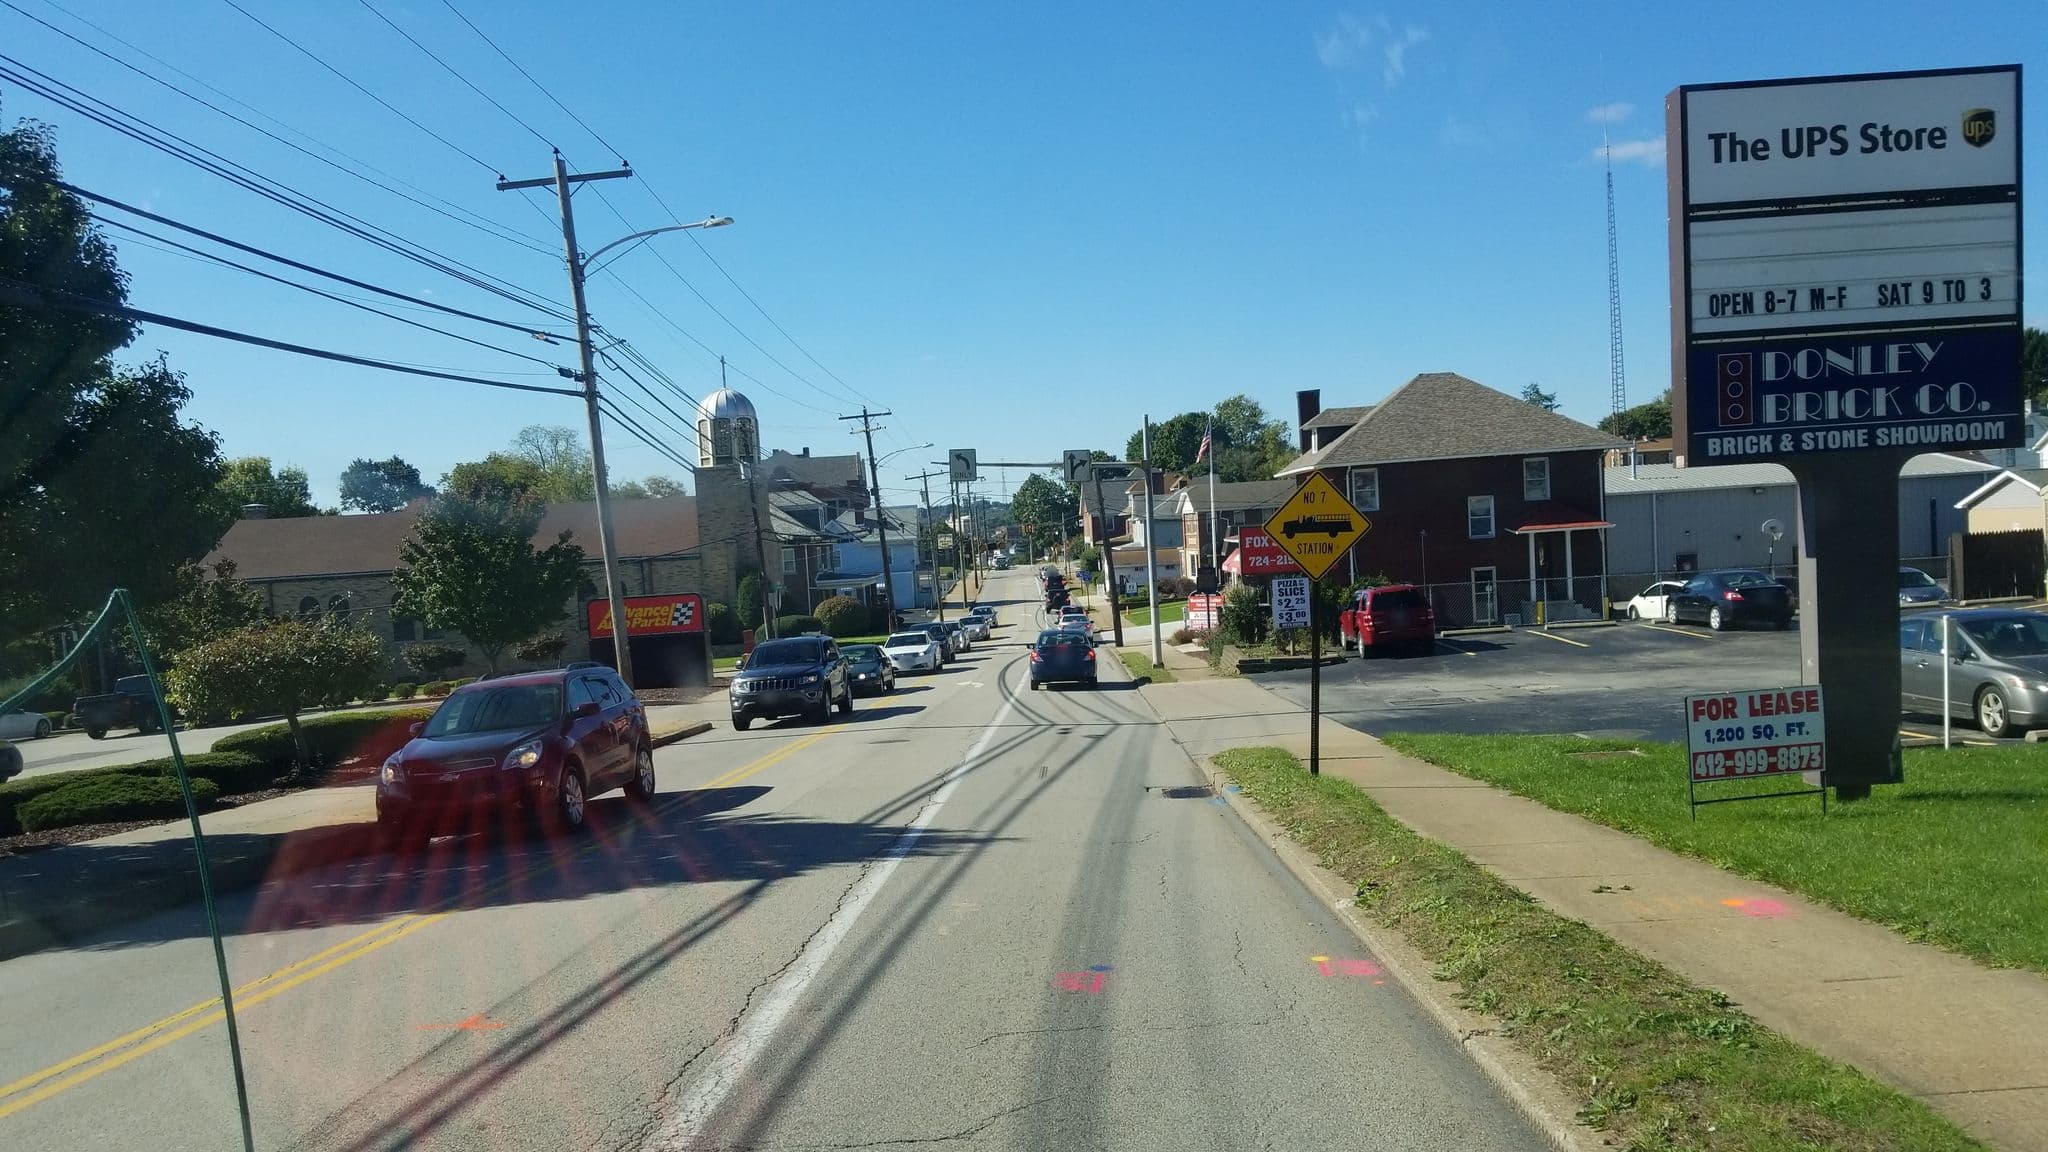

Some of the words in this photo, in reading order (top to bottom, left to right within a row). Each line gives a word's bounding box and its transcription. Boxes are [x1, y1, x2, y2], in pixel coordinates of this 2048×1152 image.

[1708, 131, 1770, 163] The
[1782, 124, 1849, 159] UPS
[1860, 122, 1948, 154] Store
[1965, 120, 1993, 142] ups
[1709, 292, 1754, 317] OPEN
[1764, 289, 1797, 313] 8-7
[1810, 286, 1847, 311] M-F
[1878, 282, 1912, 307] SAT
[1923, 280, 1934, 303] 9
[1943, 279, 1966, 302] TO
[1980, 277, 1992, 300] 3
[1762, 341, 1944, 381] DONLEY
[1762, 386, 1903, 424] BRICK
[1915, 382, 1991, 415] CO.
[1708, 433, 1773, 456] BRICK
[1780, 432, 1794, 452] &
[1801, 428, 1868, 451] STONE
[1876, 421, 2005, 446] SHOWROOM
[1303, 491, 1315, 504] NO
[1321, 491, 1326, 504] 7
[1297, 542, 1333, 555] STATION
[1277, 580, 1297, 588] PIZZA
[1278, 587, 1305, 597] SLICE
[631, 616, 667, 628] Parts
[1692, 697, 1738, 722] FOR
[1748, 690, 1820, 717] LEASE
[1704, 727, 1745, 744] 1,200
[1752, 724, 1779, 740] SQ.
[1786, 722, 1810, 737] FT.
[1695, 745, 1822, 776] 412-999-8873
